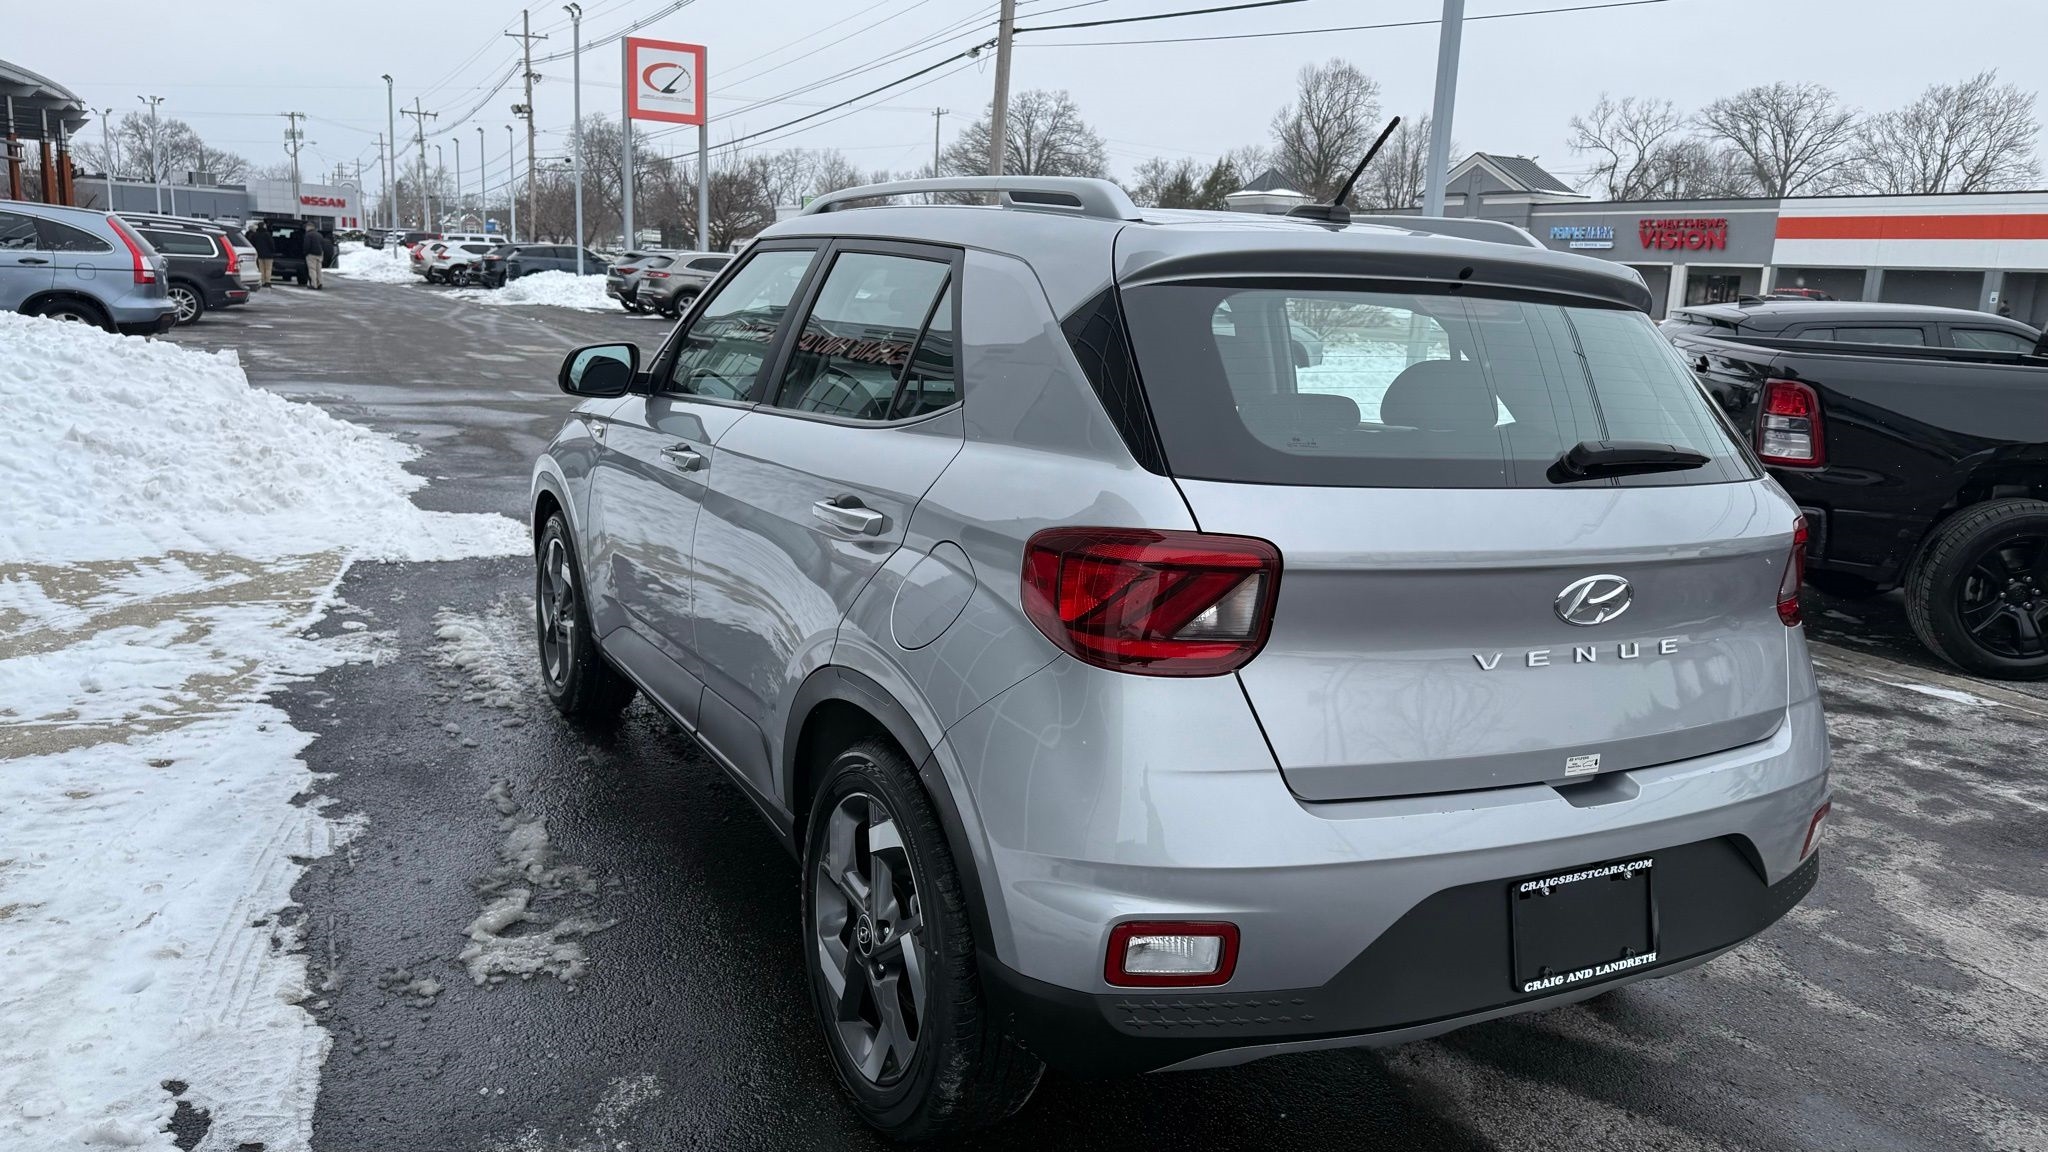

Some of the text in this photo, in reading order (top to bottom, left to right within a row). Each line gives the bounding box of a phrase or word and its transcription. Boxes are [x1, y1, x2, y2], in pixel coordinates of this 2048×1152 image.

[299, 195, 346, 208] NISSAN
[1639, 229, 1728, 250] VISION
[1472, 638, 1679, 671] VENUE
[1520, 859, 1653, 892] CRAIGSBESTCARS.COM
[1524, 952, 1657, 992] CRAIG AND LANDRETH
